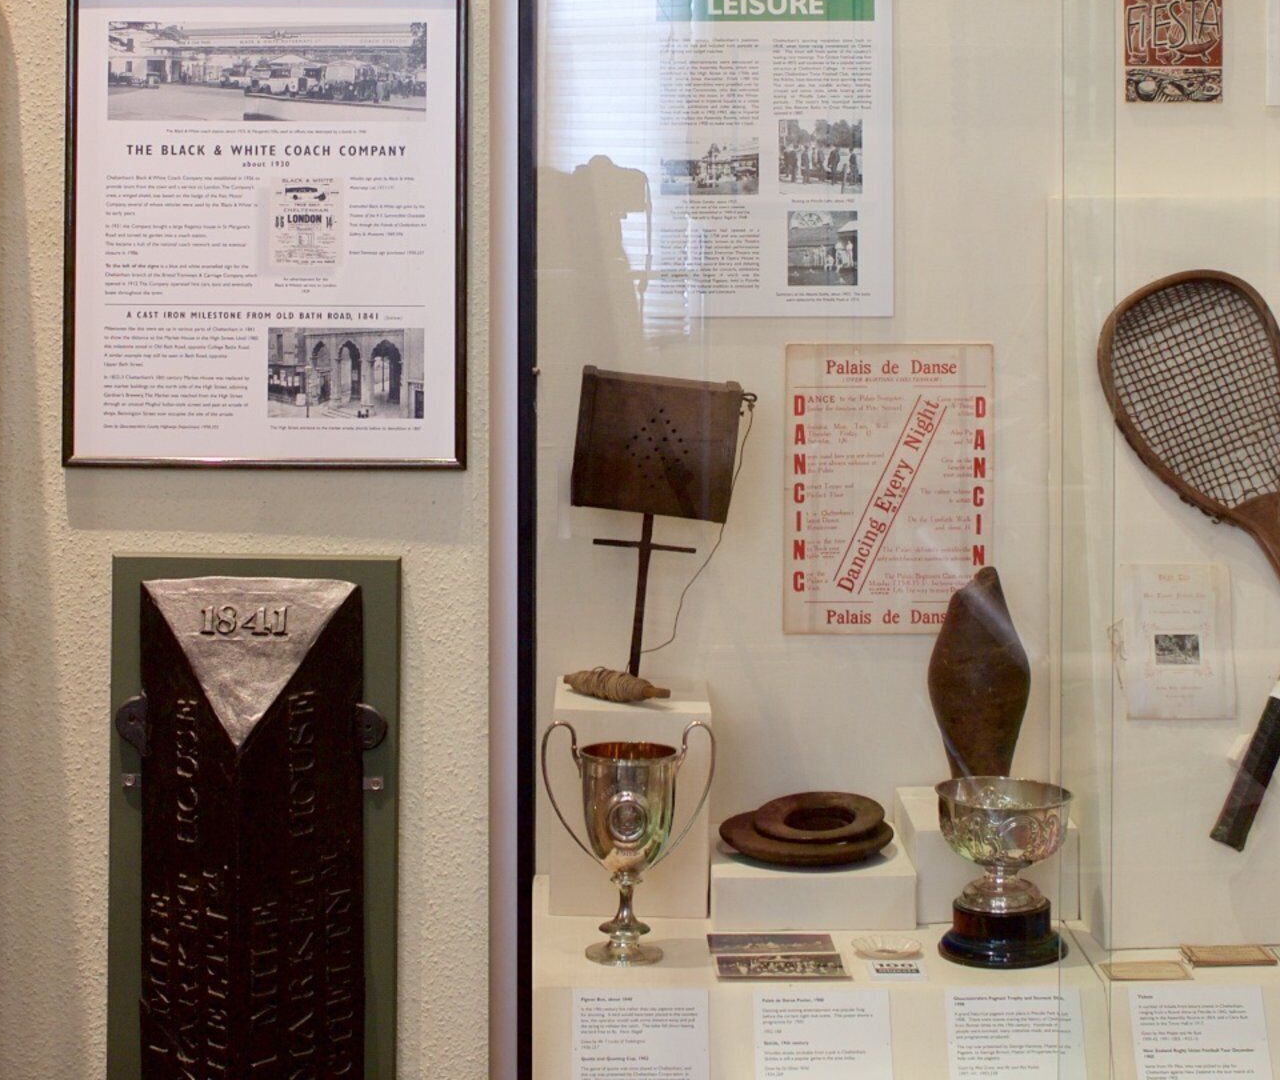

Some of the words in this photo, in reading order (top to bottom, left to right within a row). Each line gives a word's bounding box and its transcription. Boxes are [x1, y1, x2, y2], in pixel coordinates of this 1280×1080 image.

[126, 144, 153, 156] THE
[160, 144, 206, 156] BLACK
[213, 144, 223, 156] &
[230, 144, 277, 156] WHITE
[284, 145, 332, 157] COACH
[338, 145, 407, 157] COMPANY
[287, 214, 322, 224] LONDON
[126, 311, 133, 319] A
[136, 311, 159, 319] CAST
[163, 311, 186, 319] IRON
[190, 312, 242, 320] MILESTONE
[246, 312, 272, 320] FROM
[276, 312, 294, 320] OLD
[299, 312, 322, 320] BATH
[358, 312, 379, 320] 1841
[826, 359, 872, 374] Palais
[881, 359, 900, 374] de
[911, 359, 957, 374] Danse
[837, 516, 887, 592] Dancing
[874, 458, 916, 514] Every
[903, 399, 939, 452] Night
[200, 605, 289, 636] 1841
[826, 610, 872, 624] Palais
[882, 610, 900, 624] de
[911, 610, 949, 624] Dans
